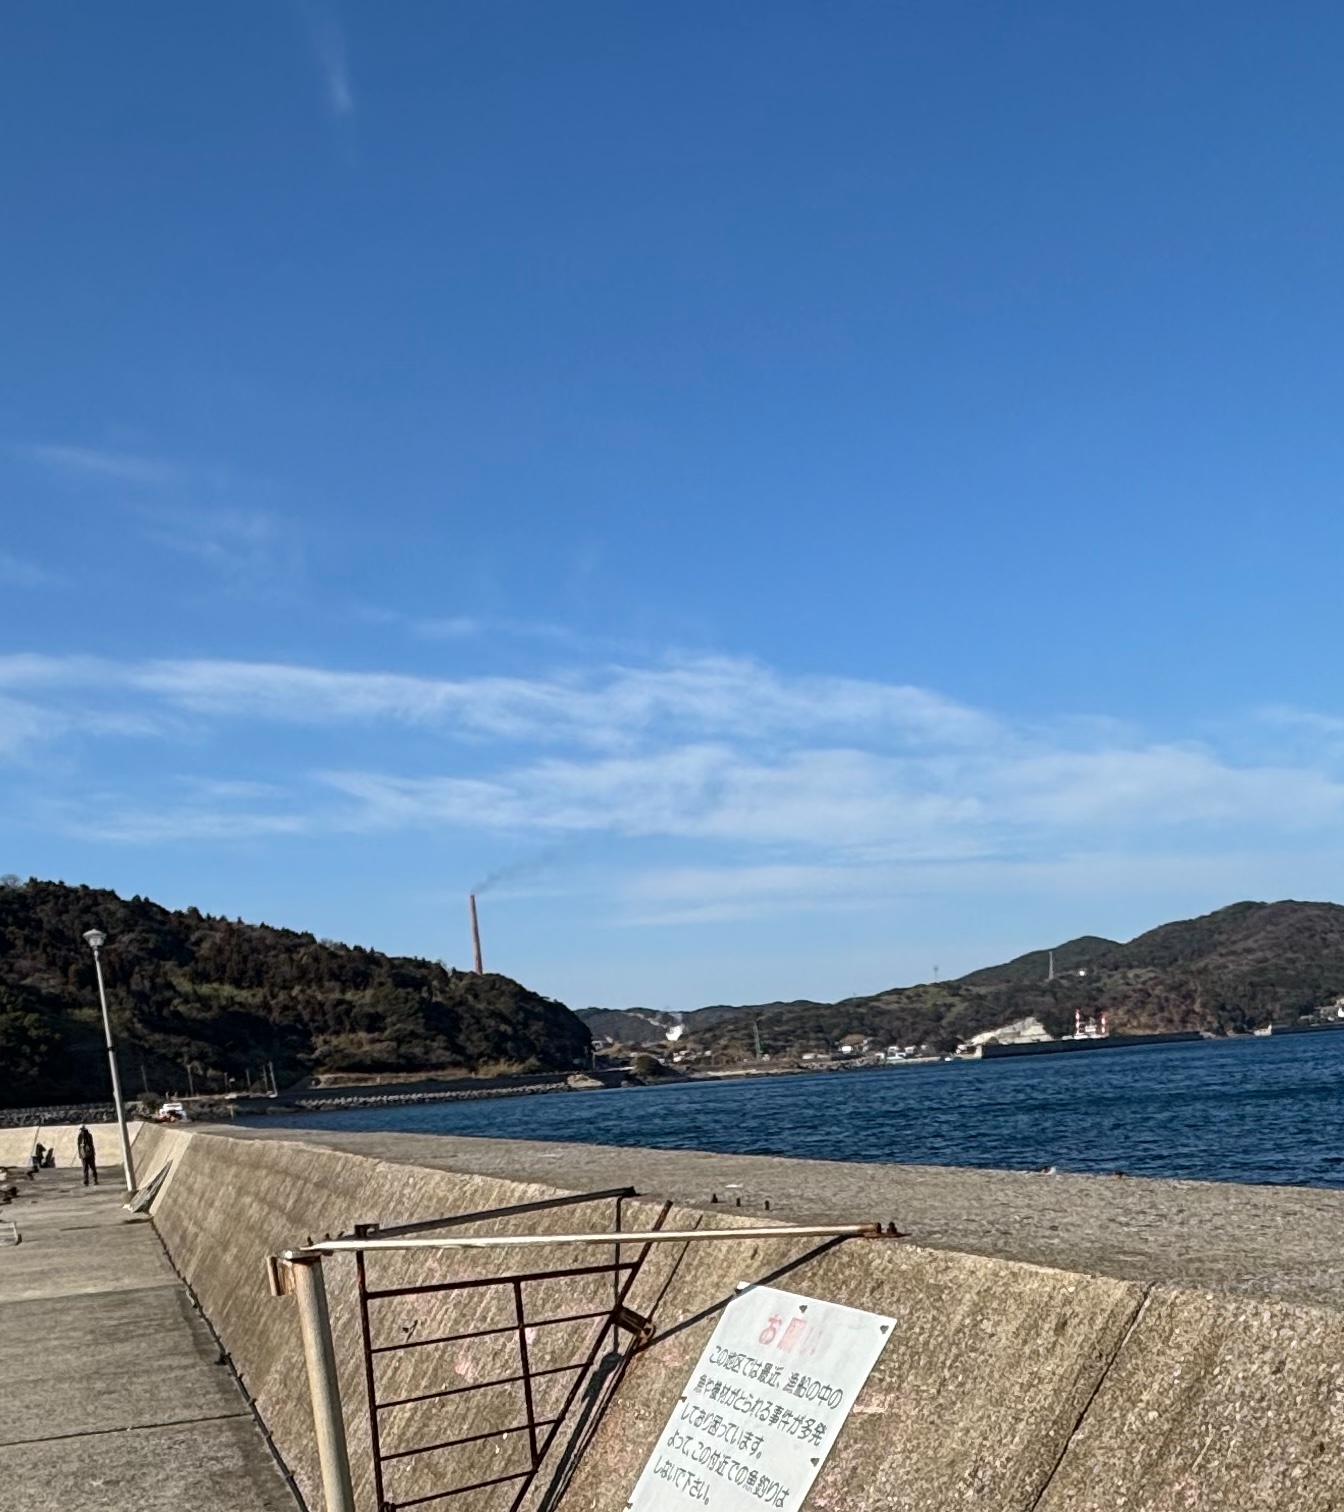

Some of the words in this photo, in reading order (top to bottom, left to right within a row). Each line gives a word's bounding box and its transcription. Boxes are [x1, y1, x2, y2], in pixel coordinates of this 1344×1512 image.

[653, 1460, 710, 1506] しないで下さい。
